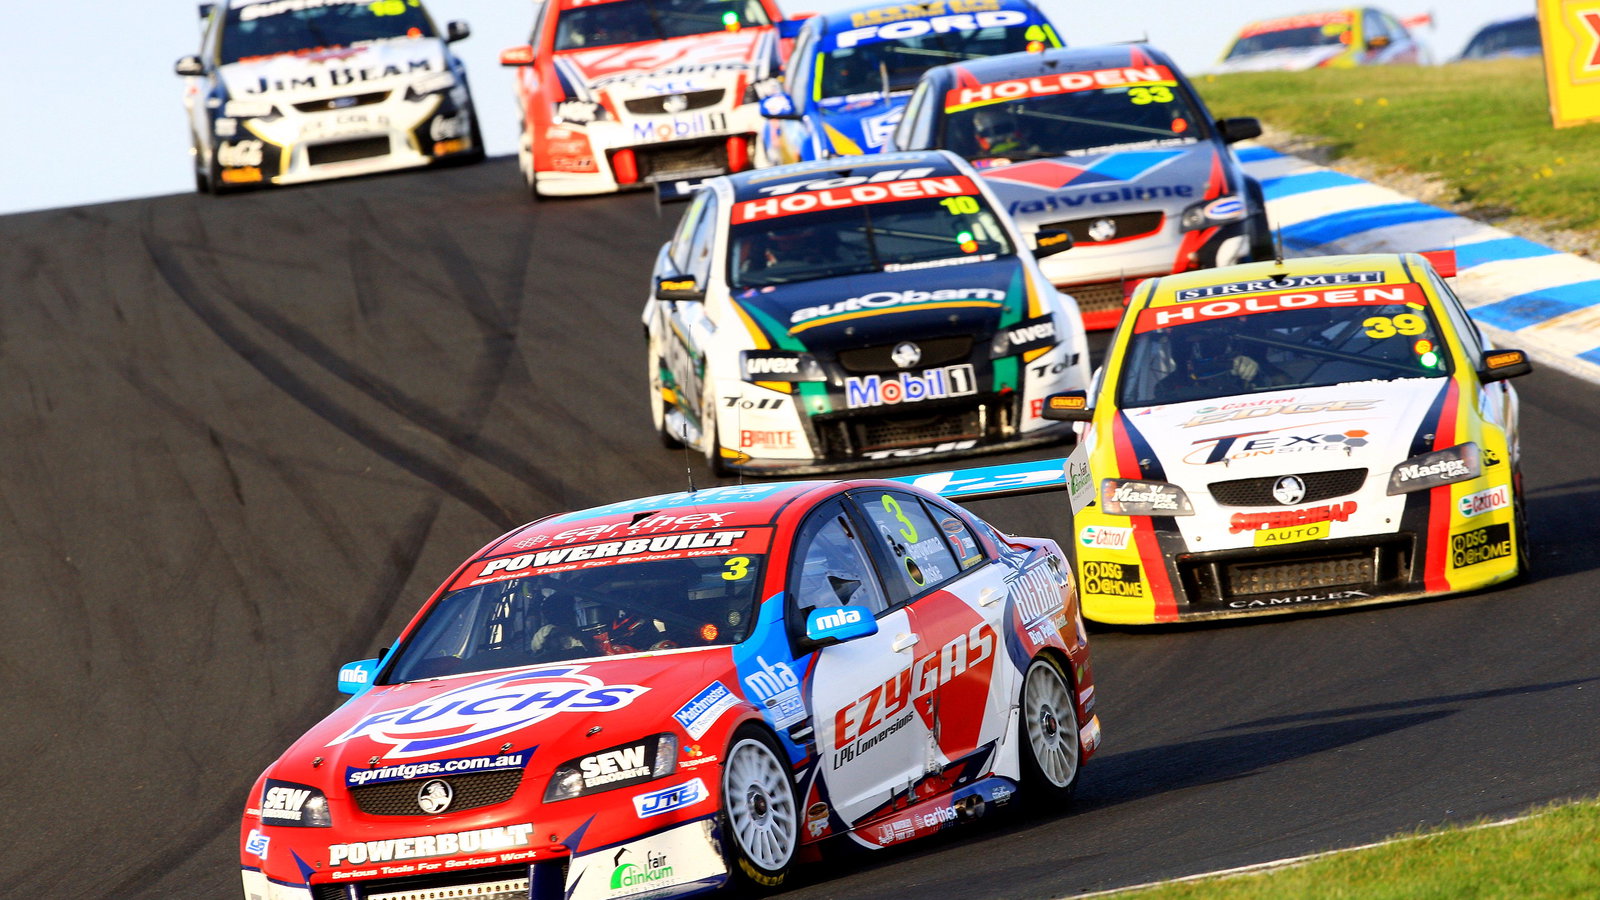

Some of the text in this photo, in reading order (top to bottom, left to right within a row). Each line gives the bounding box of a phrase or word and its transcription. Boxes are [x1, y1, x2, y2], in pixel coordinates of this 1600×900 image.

[836, 10, 1027, 48] FORD
[329, 59, 431, 87] BEAM
[960, 68, 1163, 104] HOLDEN
[1128, 85, 1174, 105] 33
[743, 178, 963, 220] HOLDEN
[939, 196, 981, 215] 10
[1185, 271, 1375, 298] SIRROMET
[1156, 288, 1405, 325] HOLDEN
[1009, 322, 1056, 345] uvex
[1362, 313, 1427, 339] 39
[747, 357, 799, 374] uvex
[846, 365, 976, 408] Mobil 1
[1178, 400, 1378, 429] EDGE
[1221, 396, 1296, 411] Castrol
[1399, 459, 1465, 482] Master
[1111, 486, 1178, 503] Master
[554, 510, 737, 540] earthex
[881, 495, 918, 543] 3
[1264, 526, 1320, 542] AUTO
[1466, 529, 1488, 548] DSG
[478, 530, 748, 578] POWERBUILT
[1466, 540, 1511, 565] @HOME
[470, 571, 533, 586] Serious
[537, 563, 581, 576] Tools
[585, 558, 614, 569] For
[616, 553, 680, 565] Serious
[721, 557, 751, 580] 3
[1100, 562, 1123, 580] DSG
[1101, 579, 1143, 597] @HOME
[1230, 590, 1372, 608] CAMPLEX
[342, 687, 634, 740] FUCHS
[833, 710, 914, 771] LPG Conversions
[348, 752, 524, 785] sprintgas.com.au
[579, 745, 646, 779] SEW
[263, 787, 312, 811] SEW
[923, 805, 958, 827] earthex
[328, 823, 534, 867] POWERBUILT
[332, 850, 537, 880] Serious Tools For Serious Work
[647, 850, 667, 870] fair
[622, 863, 674, 887] dinkum
